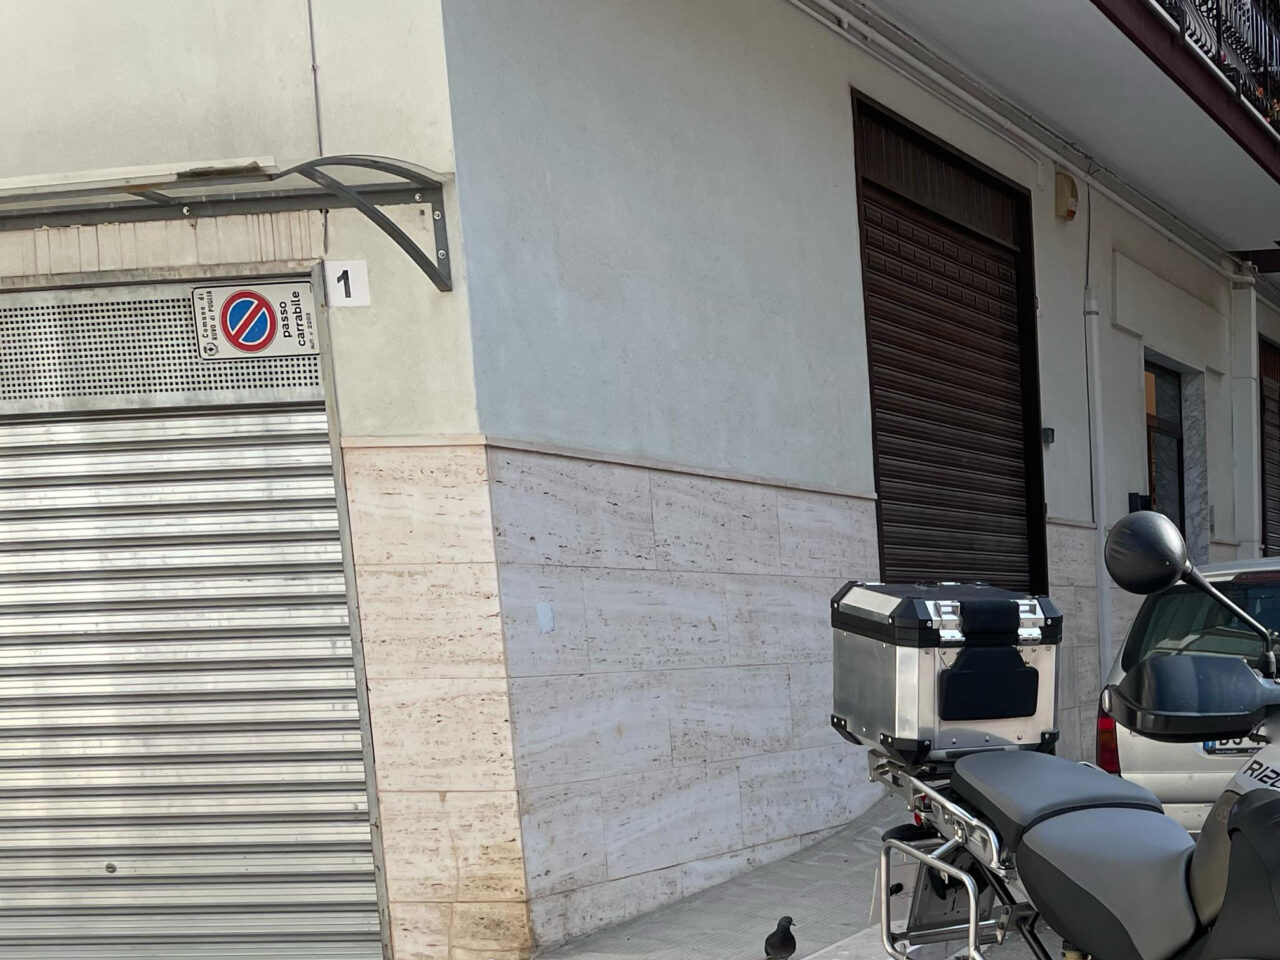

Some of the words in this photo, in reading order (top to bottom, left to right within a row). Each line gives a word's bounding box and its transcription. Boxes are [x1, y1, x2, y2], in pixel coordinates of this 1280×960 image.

[197, 293, 205, 301] di
[337, 270, 352, 299] 1
[206, 290, 215, 312] PUGLIA
[200, 306, 209, 339] Comune
[279, 301, 292, 338] passo
[291, 291, 306, 347] carrabile
